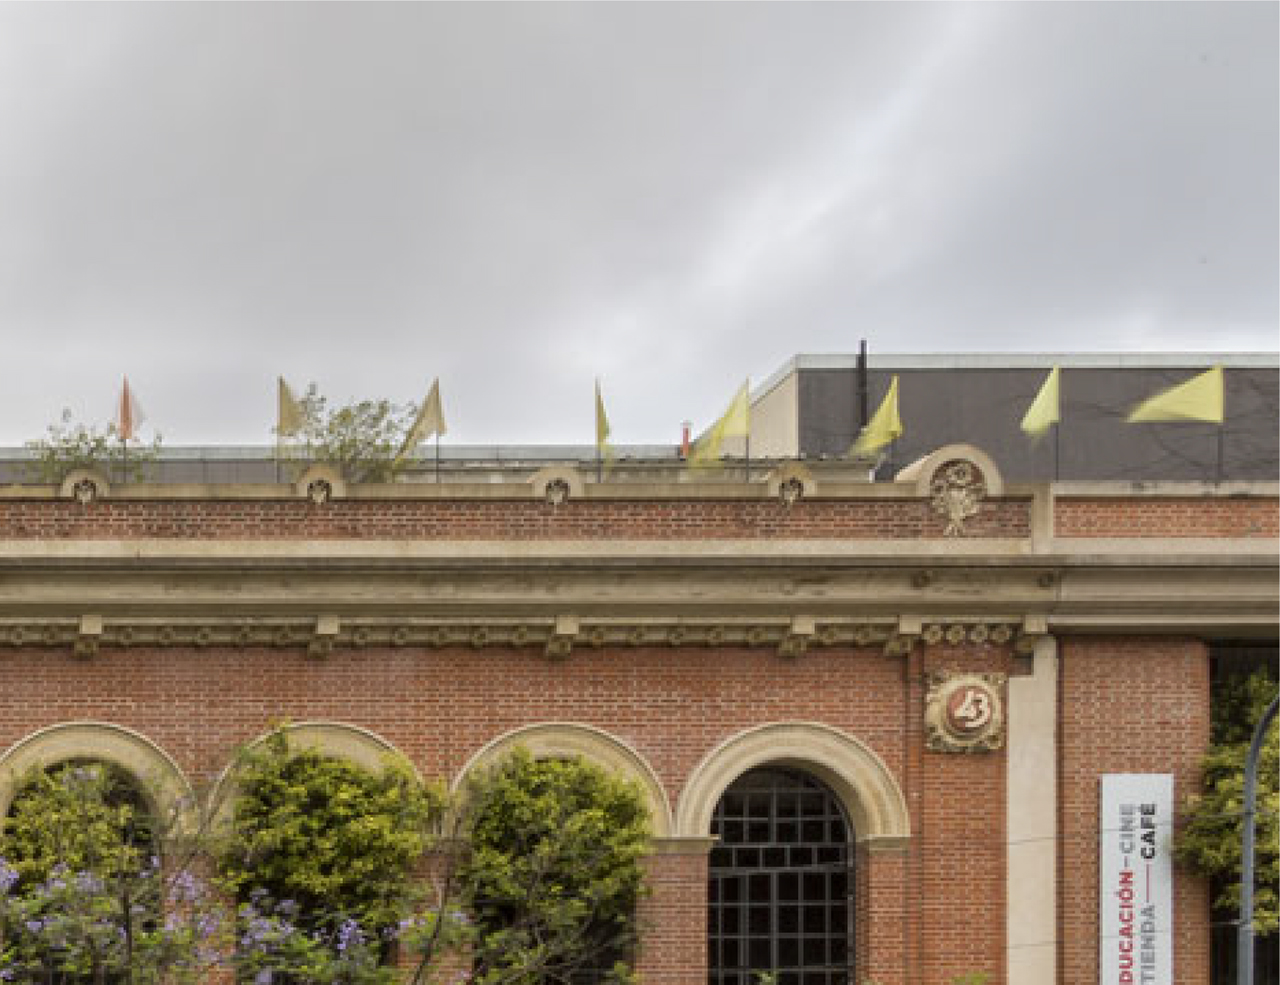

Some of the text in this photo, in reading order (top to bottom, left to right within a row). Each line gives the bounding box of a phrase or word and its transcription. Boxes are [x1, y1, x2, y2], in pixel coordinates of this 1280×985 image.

[1119, 803, 1134, 854] CINE
[1138, 803, 1156, 859] CAFÉ
[1140, 904, 1155, 985] TIENDA
